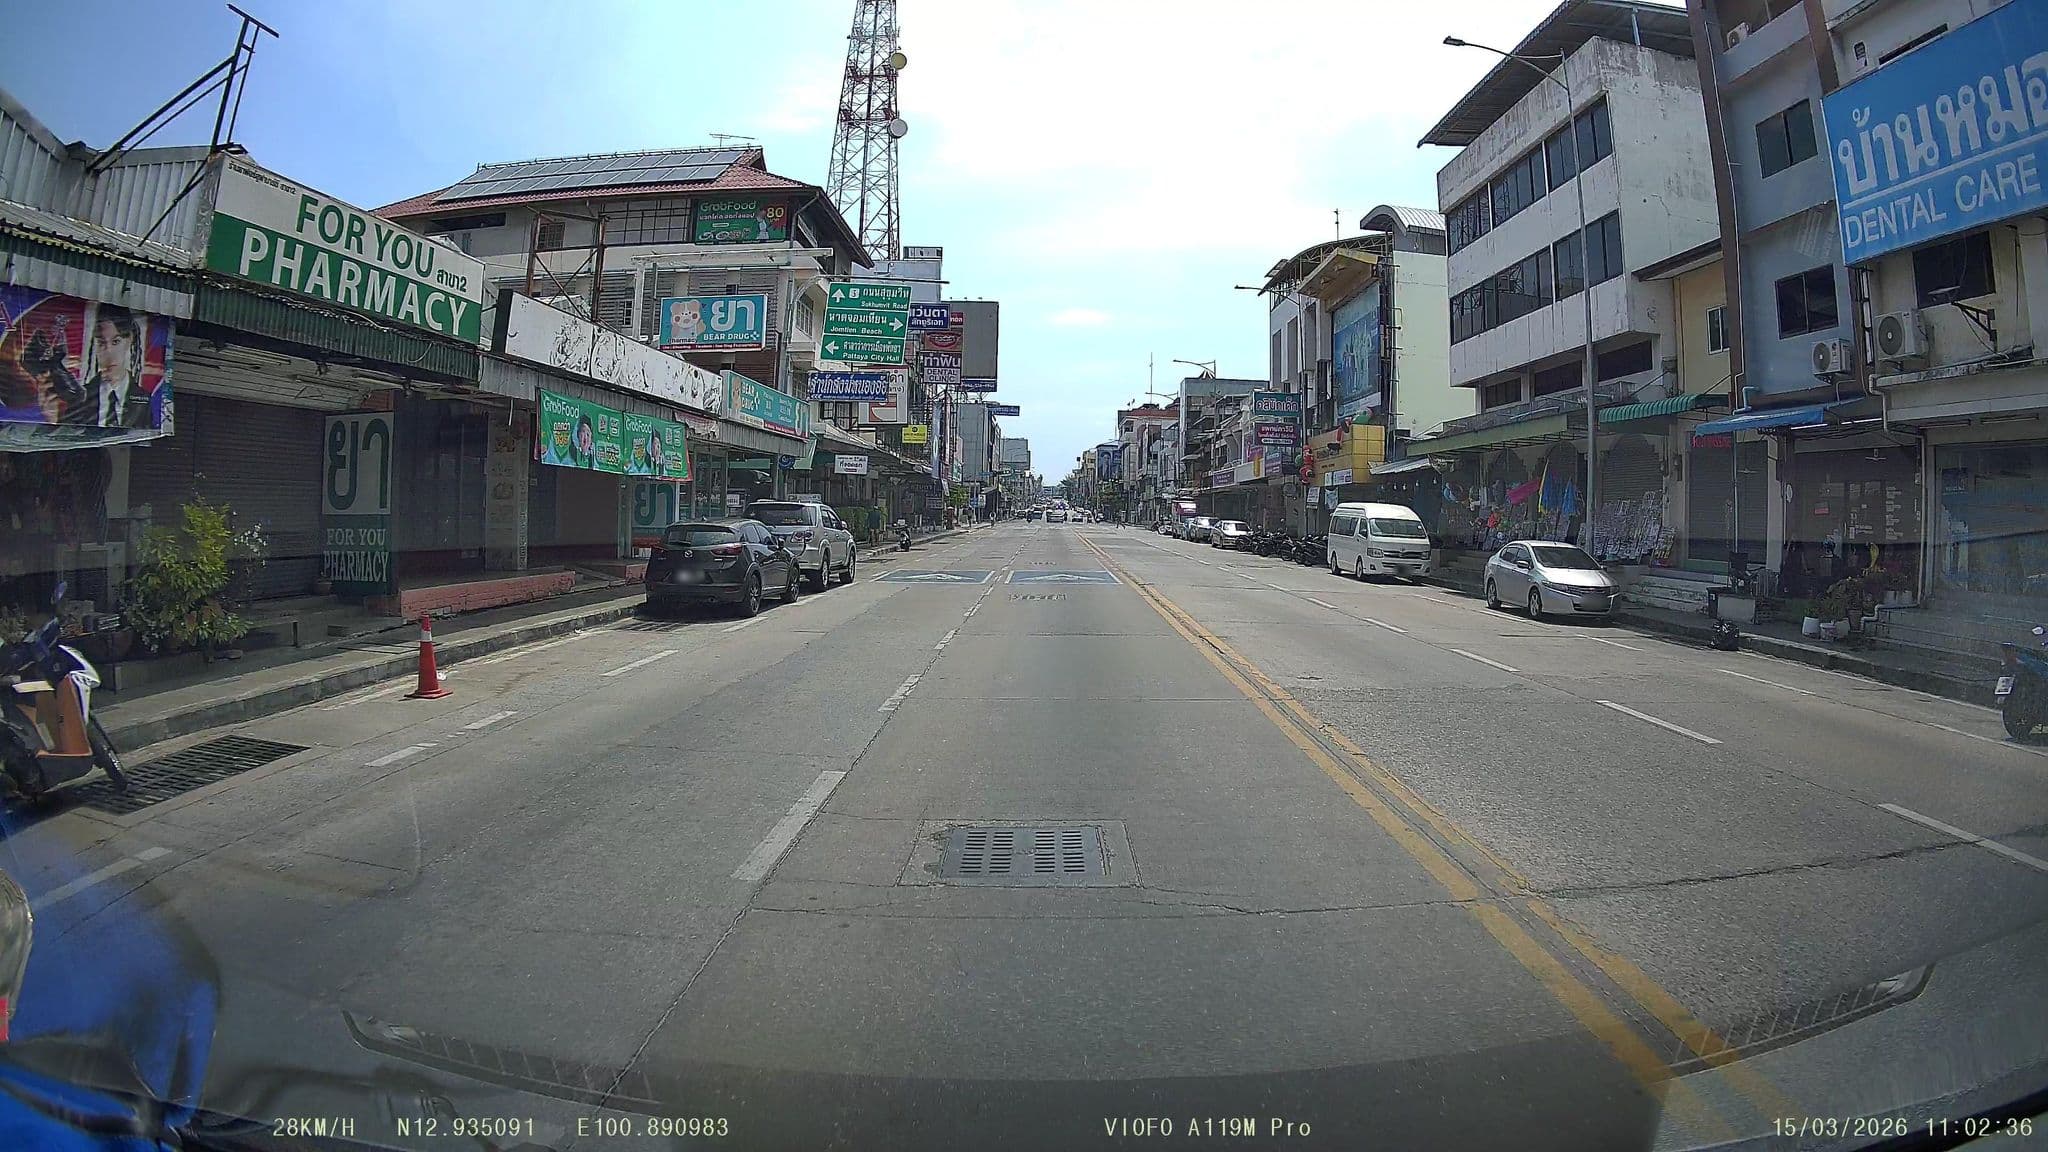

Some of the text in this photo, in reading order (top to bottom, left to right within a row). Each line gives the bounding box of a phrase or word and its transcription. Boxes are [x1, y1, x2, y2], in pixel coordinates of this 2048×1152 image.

[700, 200, 756, 212] GrabFood
[1843, 153, 2041, 249] DENTAL CARE
[766, 207, 784, 218] 80
[296, 194, 435, 278] FOR YOU
[239, 227, 468, 336] PHARMACY
[436, 268, 467, 293] สาขา2
[862, 287, 909, 300] ถนนสุขุมวิท
[711, 300, 755, 332] ยา
[829, 312, 887, 324] หาดจอมเทียน
[703, 332, 750, 341] BEAR DRUG
[843, 352, 868, 360] Pattaya
[924, 352, 960, 367] ทำฟัน
[543, 397, 580, 418] GrabFood
[625, 416, 653, 433] GrabFood
[327, 418, 390, 510] ยา
[634, 483, 676, 525] ยา
[326, 528, 387, 546] FOR YOU
[323, 550, 389, 583] PHARMACY
